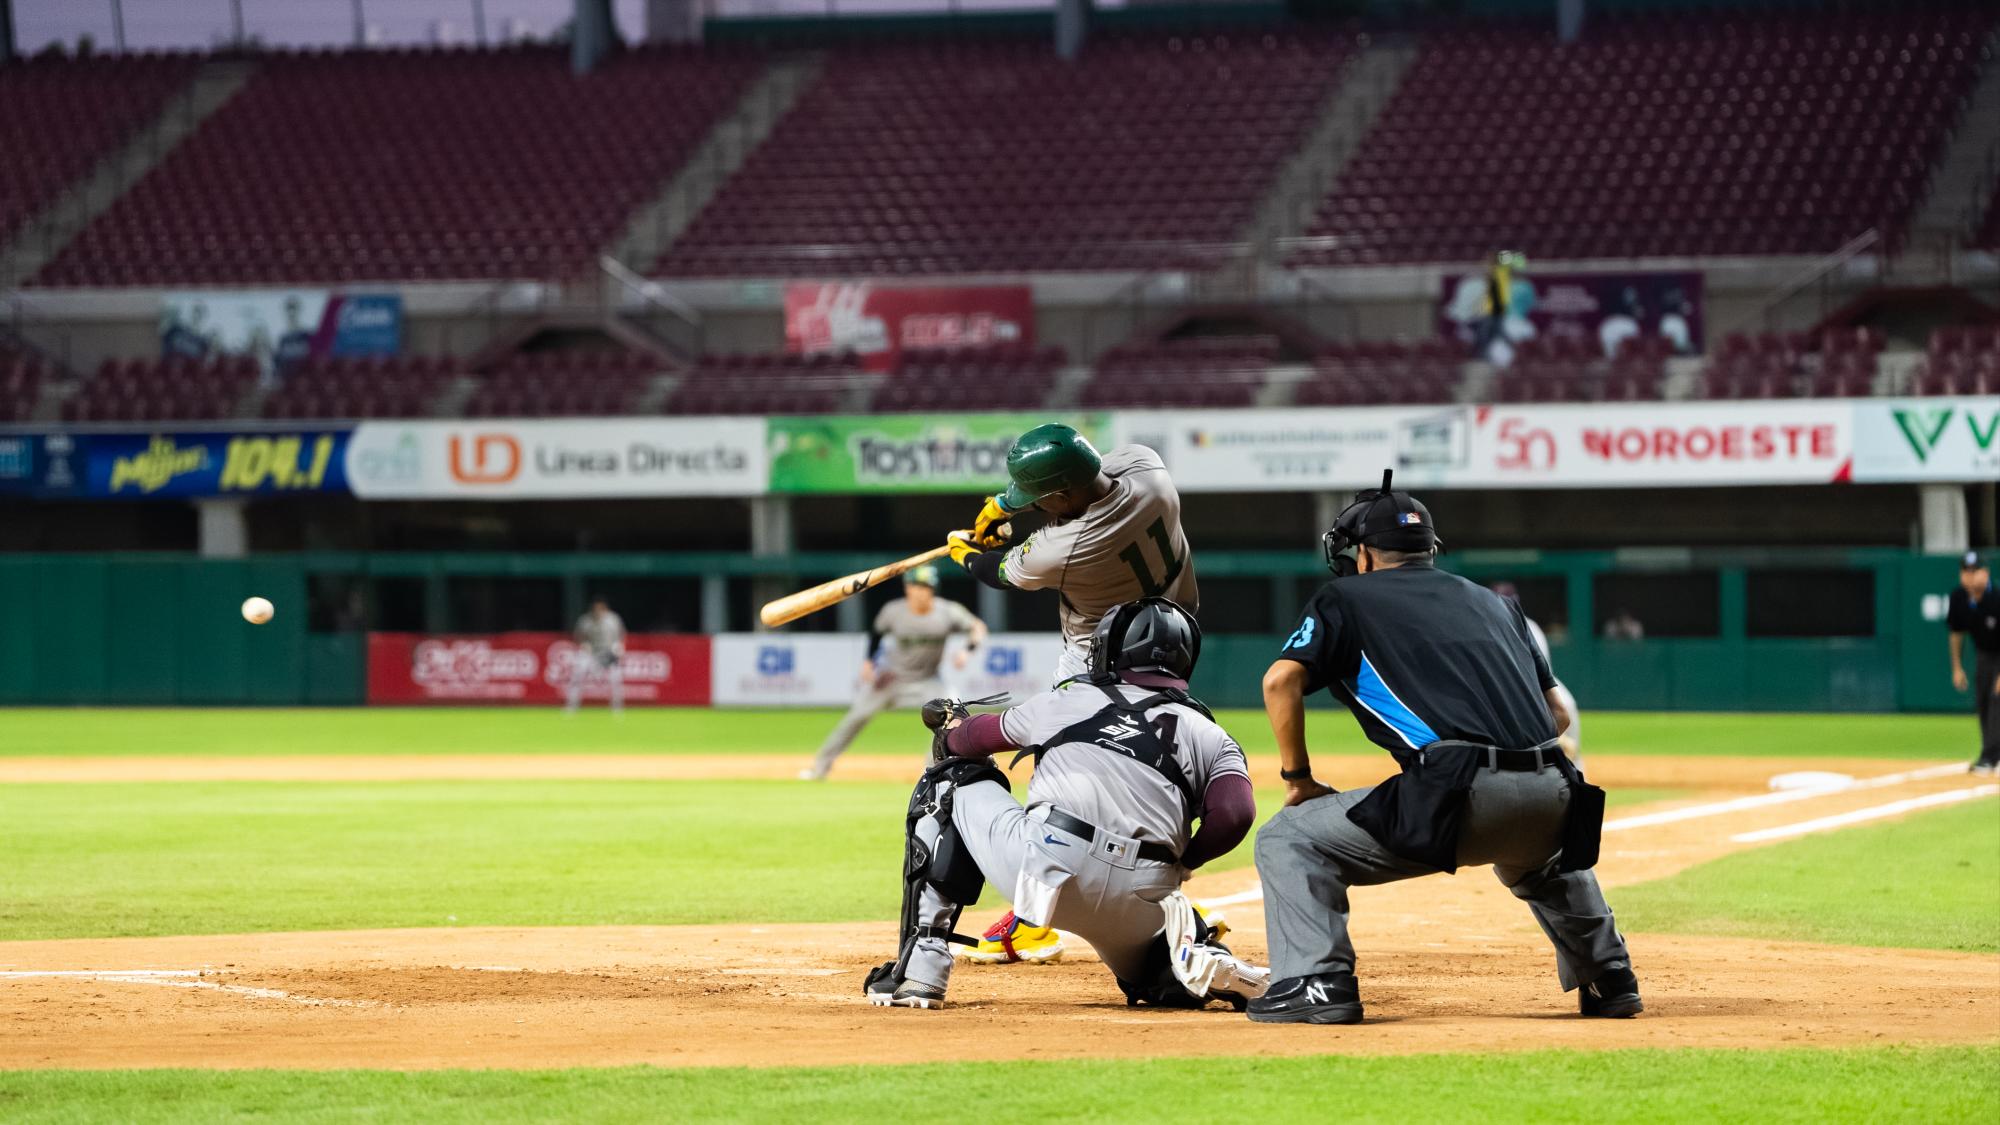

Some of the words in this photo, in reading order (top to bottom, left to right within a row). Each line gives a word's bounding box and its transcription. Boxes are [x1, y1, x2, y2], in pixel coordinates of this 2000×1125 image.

[220, 435, 334, 489] 104.1
[628, 441, 748, 474] Directa
[1583, 424, 1837, 460] NOROESTE
[1118, 515, 1184, 600] 11
